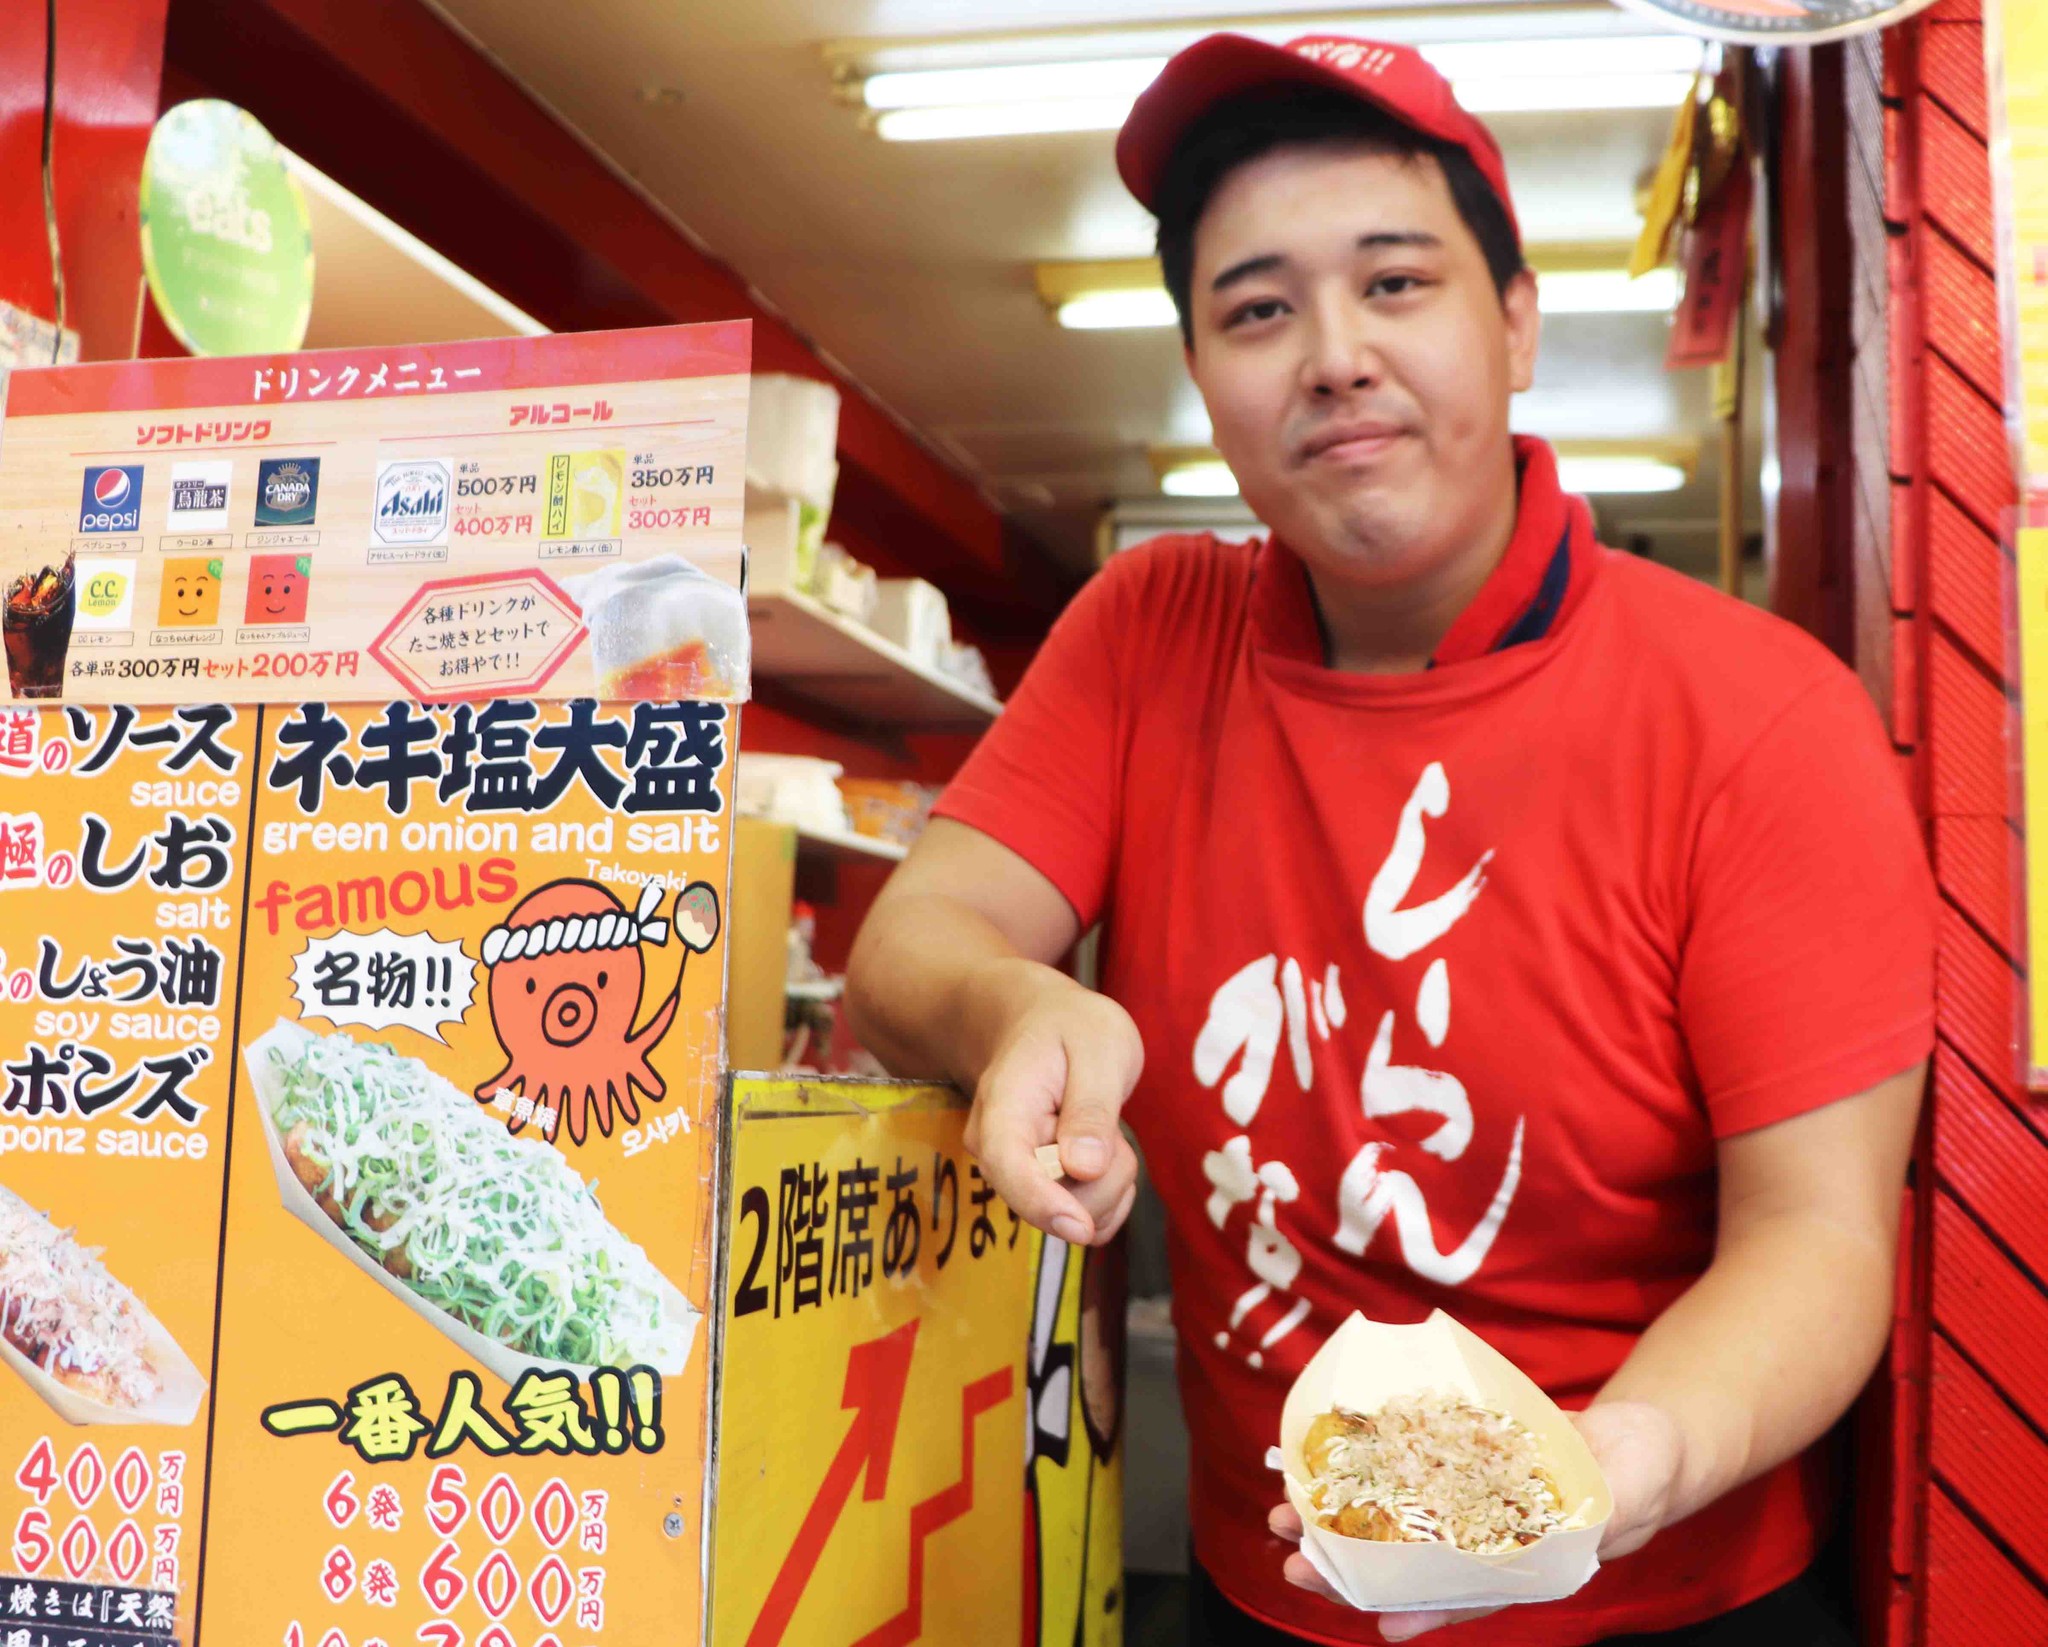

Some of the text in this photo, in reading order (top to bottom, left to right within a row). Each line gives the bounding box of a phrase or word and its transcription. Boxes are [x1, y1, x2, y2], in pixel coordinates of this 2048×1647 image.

[253, 363, 482, 401] ドリンクメニュー
[509, 401, 614, 426] アルコール
[137, 420, 272, 445] ソフトドリンク
[459, 462, 480, 473] 単品
[633, 454, 655, 465] 単品
[265, 482, 310, 495] CANADA
[457, 474, 537, 496] 500万円
[631, 465, 714, 488] 350万円
[277, 491, 298, 503] DRY
[381, 489, 443, 517] Asahi
[455, 503, 481, 515] セット
[629, 494, 656, 506] セット
[82, 508, 138, 532] pepsi
[454, 514, 534, 536] 400万円
[628, 506, 711, 529] 300万円
[423, 594, 536, 625] 各種ドリンクが
[409, 620, 549, 653] たこ焼きとセットで
[439, 652, 520, 677] お得やで!!
[268, 700, 728, 813] ネギ塩大盛
[130, 780, 241, 808] sauce
[262, 815, 721, 853] green onion and salt
[585, 858, 688, 891] Takoyaki
[256, 857, 519, 936] famous
[155, 899, 231, 929] salt
[0, 937, 222, 1007] のしょう油
[312, 951, 452, 1008] 名物!!
[34, 1011, 221, 1041] soy sauce
[2, 1043, 210, 1123] ポンズ
[0, 1123, 209, 1160] ponz sauce
[621, 1106, 692, 1157] 오사카
[262, 1365, 664, 1463] 一番人気!!
[17, 1439, 184, 1512] 400万円
[425, 1463, 608, 1554] 500万円
[13, 1509, 180, 1584] 500万円
[419, 1538, 605, 1631] 600万円
[0, 1582, 174, 1629] 焼きは『天然
